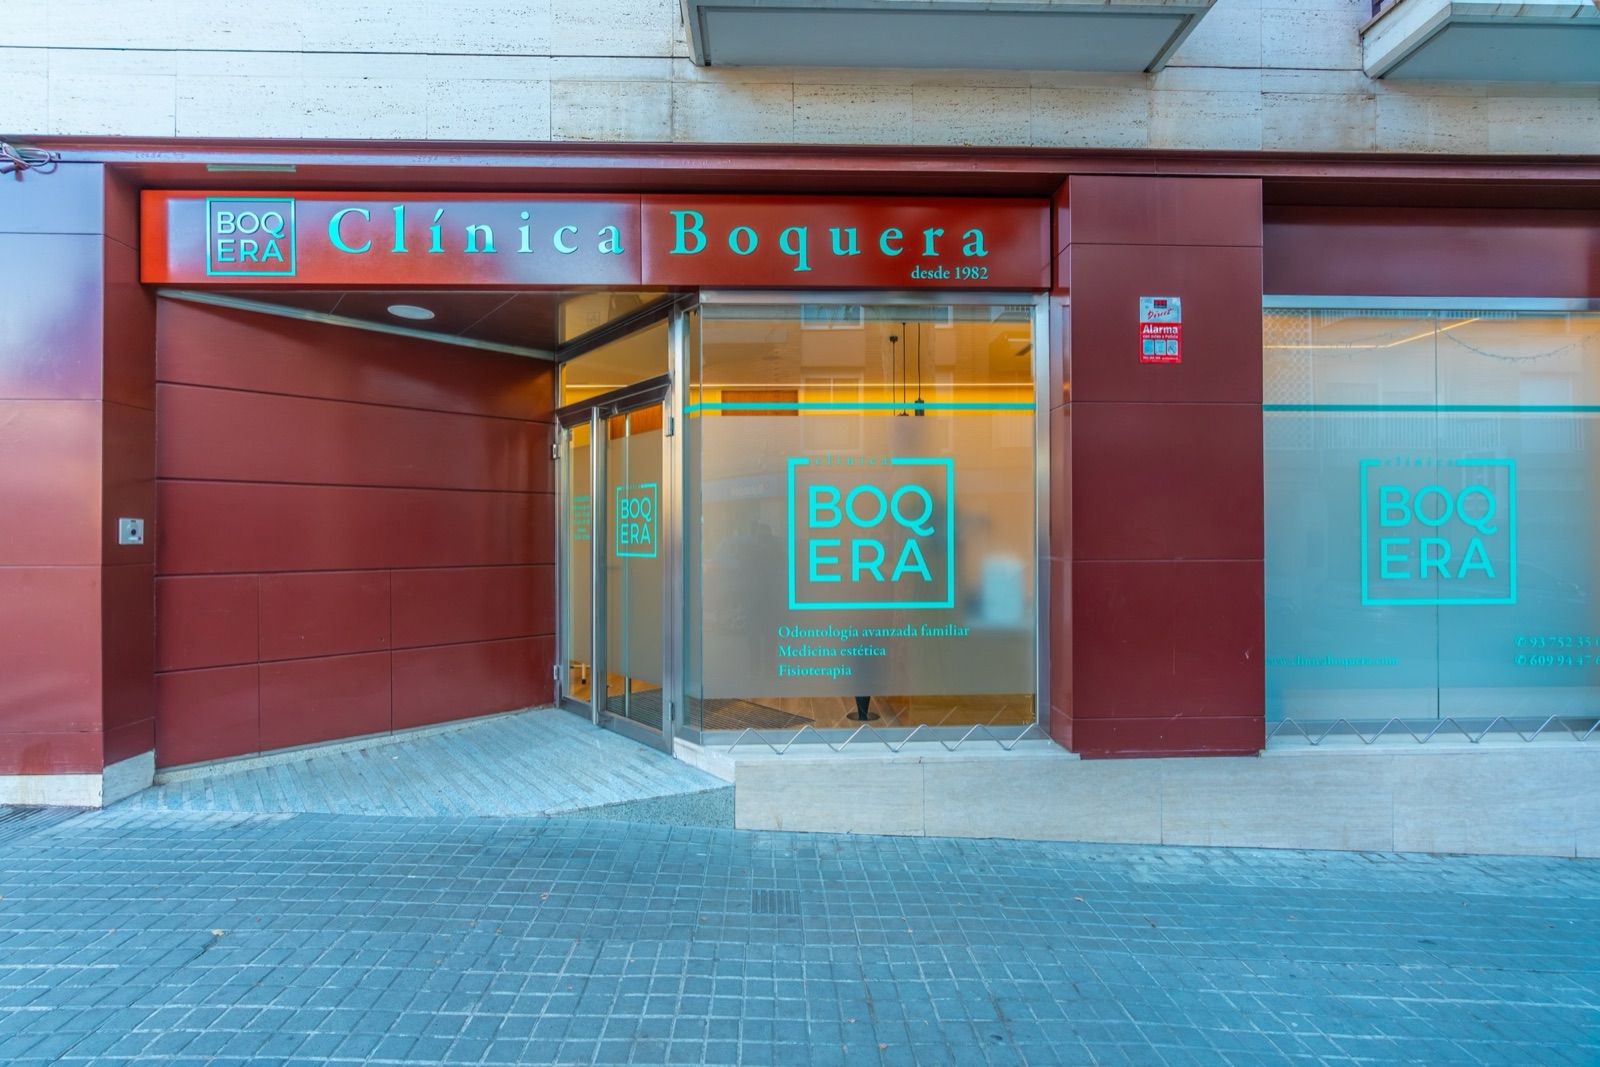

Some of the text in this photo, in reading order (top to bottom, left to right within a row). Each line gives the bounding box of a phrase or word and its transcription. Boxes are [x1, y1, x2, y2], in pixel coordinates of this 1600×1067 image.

[217, 211, 285, 238] BOQ
[328, 205, 989, 272] Clínica Boquera
[217, 239, 285, 262] ERA
[911, 265, 989, 281] desde 1982
[1143, 325, 1178, 334] Alarma
[620, 497, 652, 522] BOQ
[808, 484, 935, 537] BOQ
[1379, 484, 1498, 535] BOQ
[620, 522, 651, 545] ERA
[808, 538, 932, 582] ERA
[1380, 537, 1496, 579] ERA
[861, 624, 918, 638] avanzada
[920, 623, 970, 637] familiar
[778, 644, 886, 657] Medicina estética
[1529, 654, 1554, 666] 609
[778, 663, 852, 679] Fisioterapia
